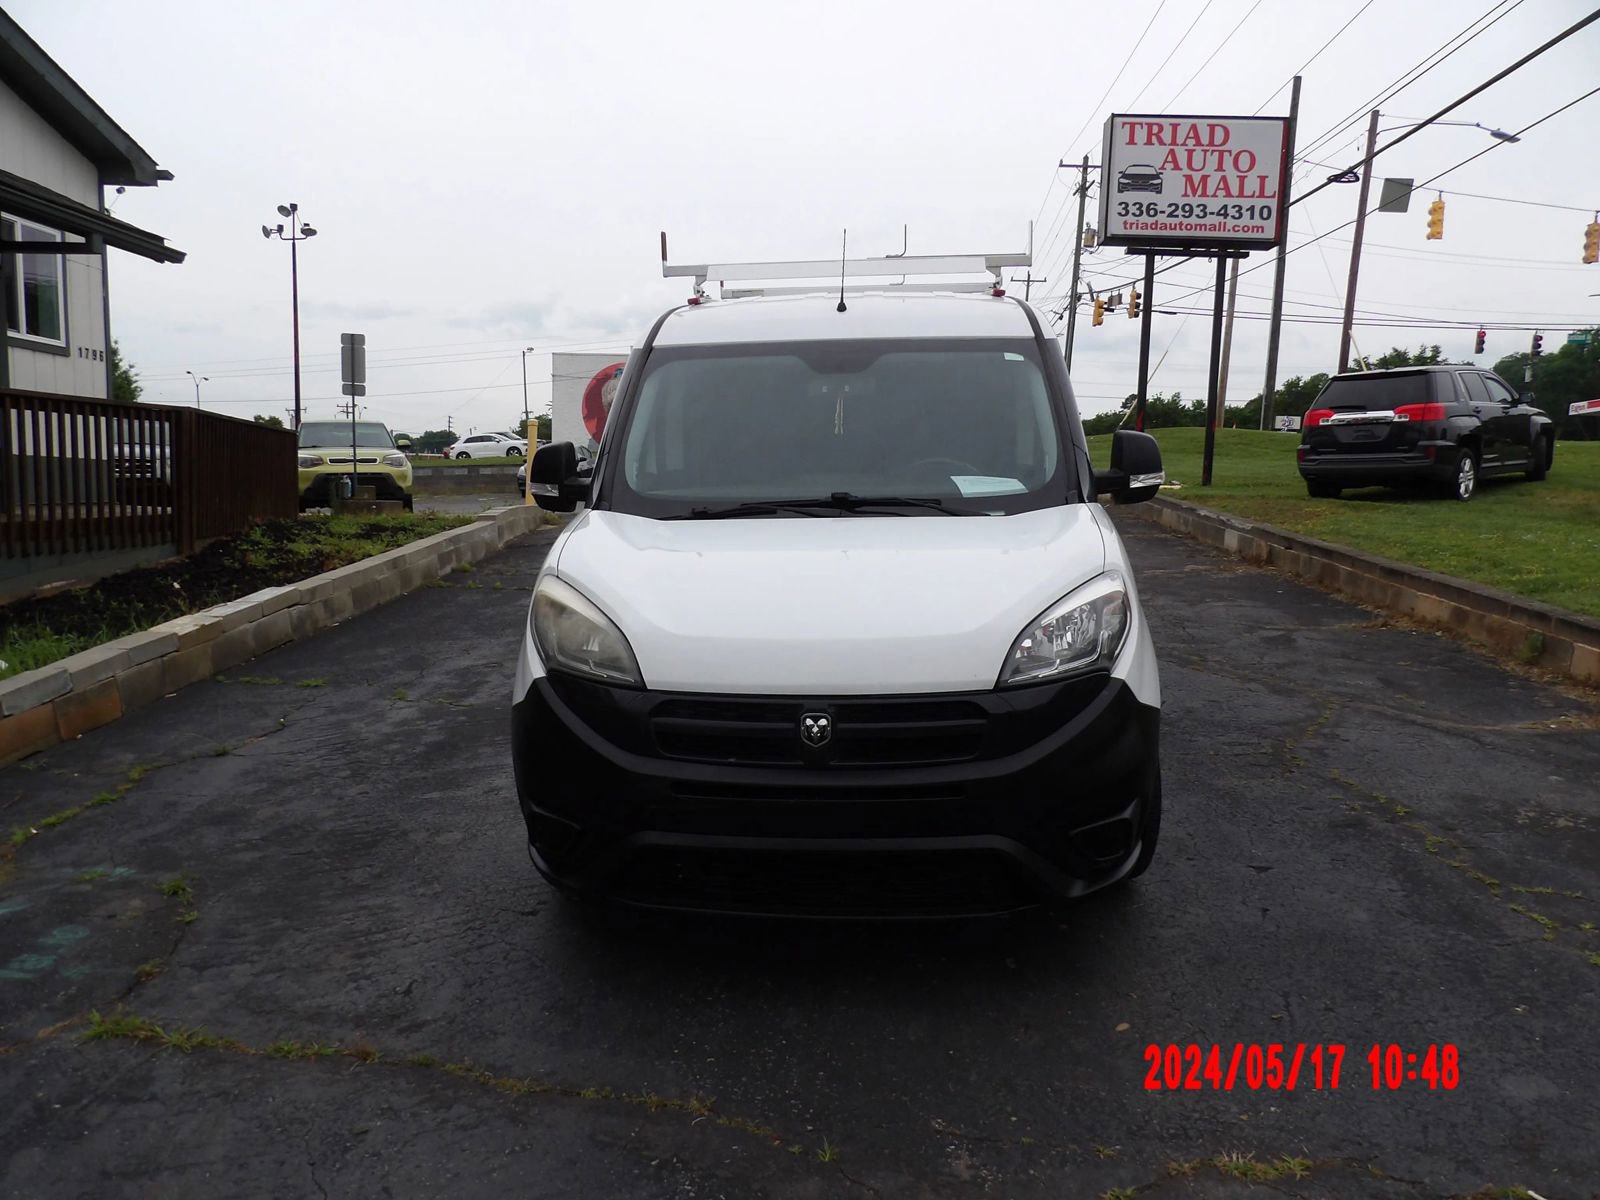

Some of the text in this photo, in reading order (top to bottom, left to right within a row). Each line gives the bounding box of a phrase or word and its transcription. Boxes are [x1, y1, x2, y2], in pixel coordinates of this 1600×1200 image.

[1122, 121, 1231, 148] TRIAD
[1158, 148, 1257, 174] AUTO
[1181, 174, 1277, 199] MALL
[1116, 201, 1273, 221] 336-293-4310
[1122, 219, 1266, 234] triadautomall.com
